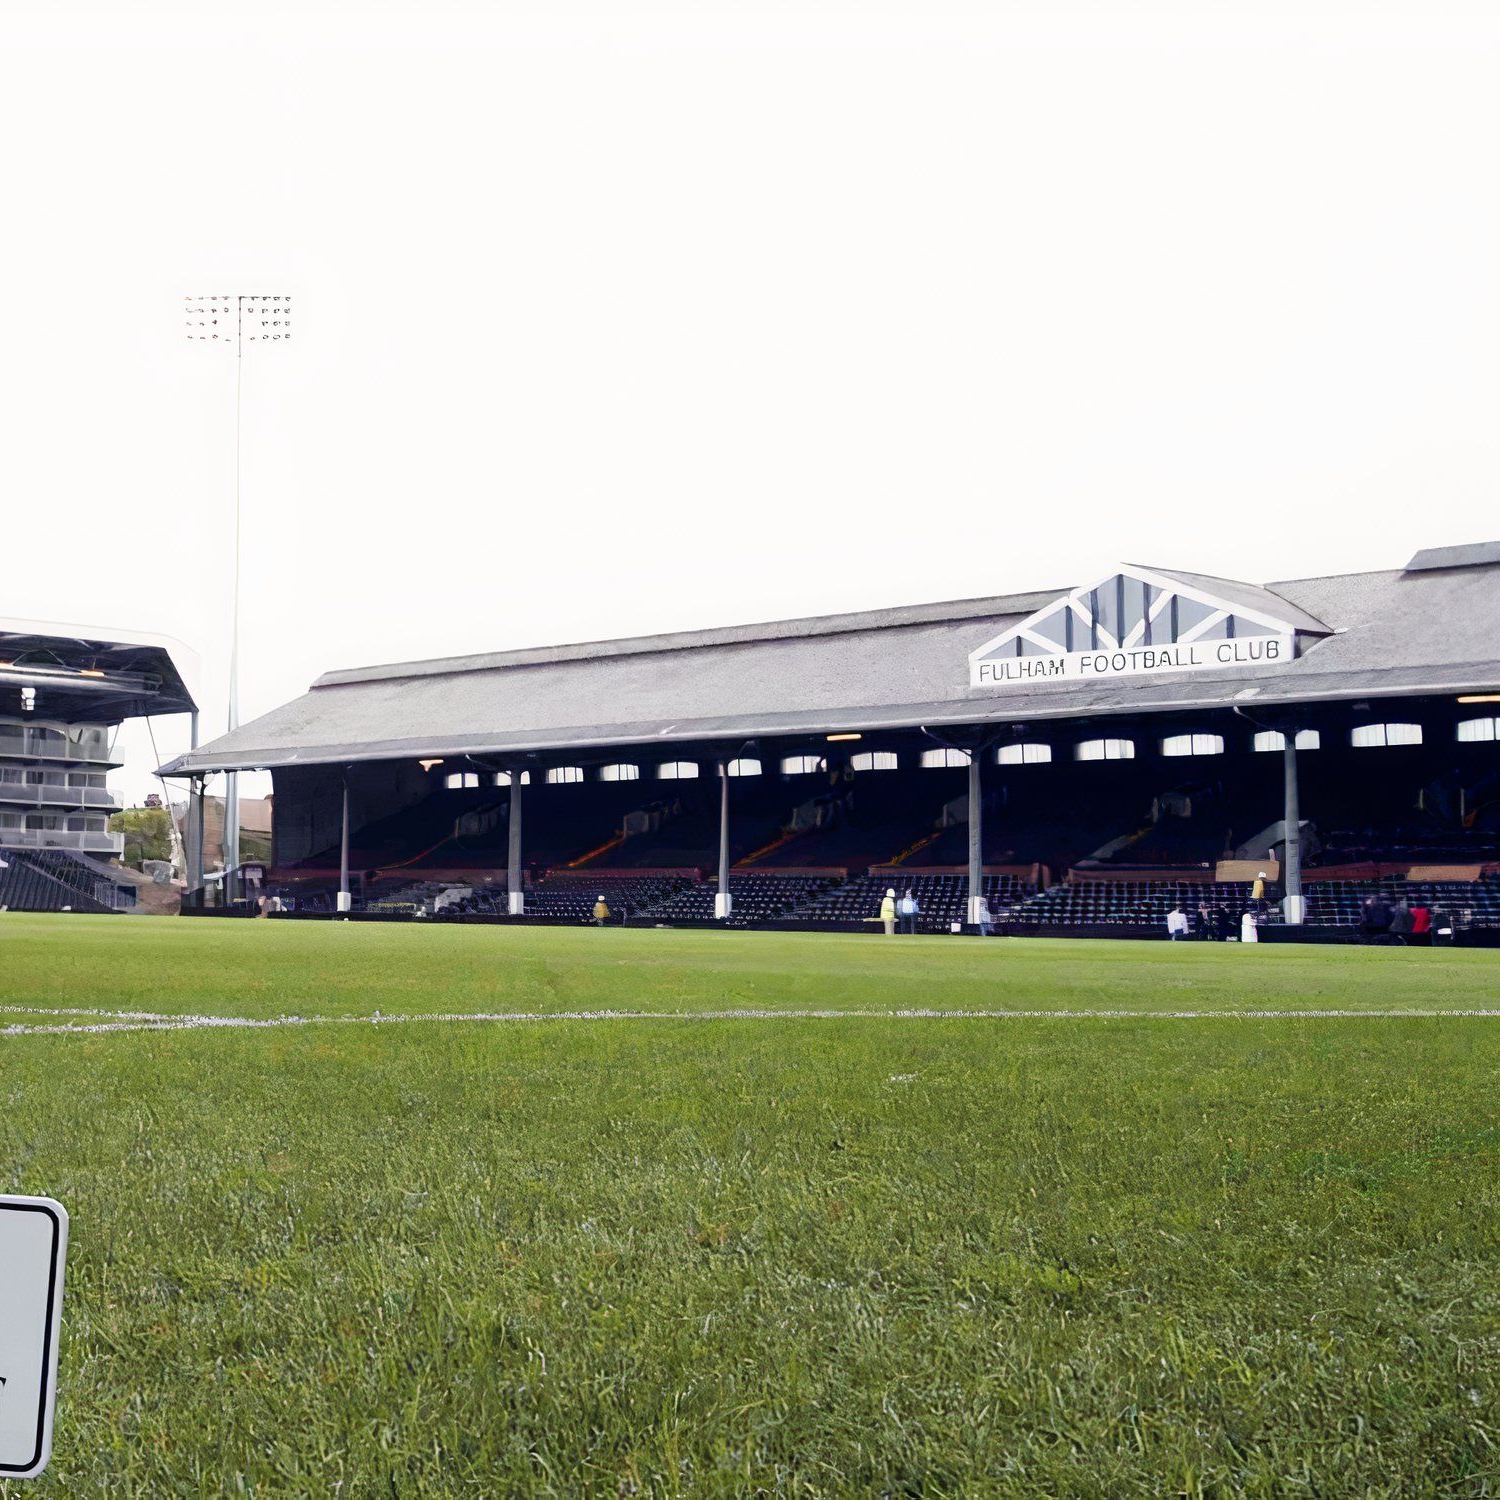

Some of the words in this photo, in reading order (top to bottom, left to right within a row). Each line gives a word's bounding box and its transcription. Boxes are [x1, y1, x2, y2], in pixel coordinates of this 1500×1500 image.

[979, 658, 1066, 682] FULHAM
[1080, 647, 1203, 674] FOOTBALL
[1217, 640, 1280, 663] CLUB
